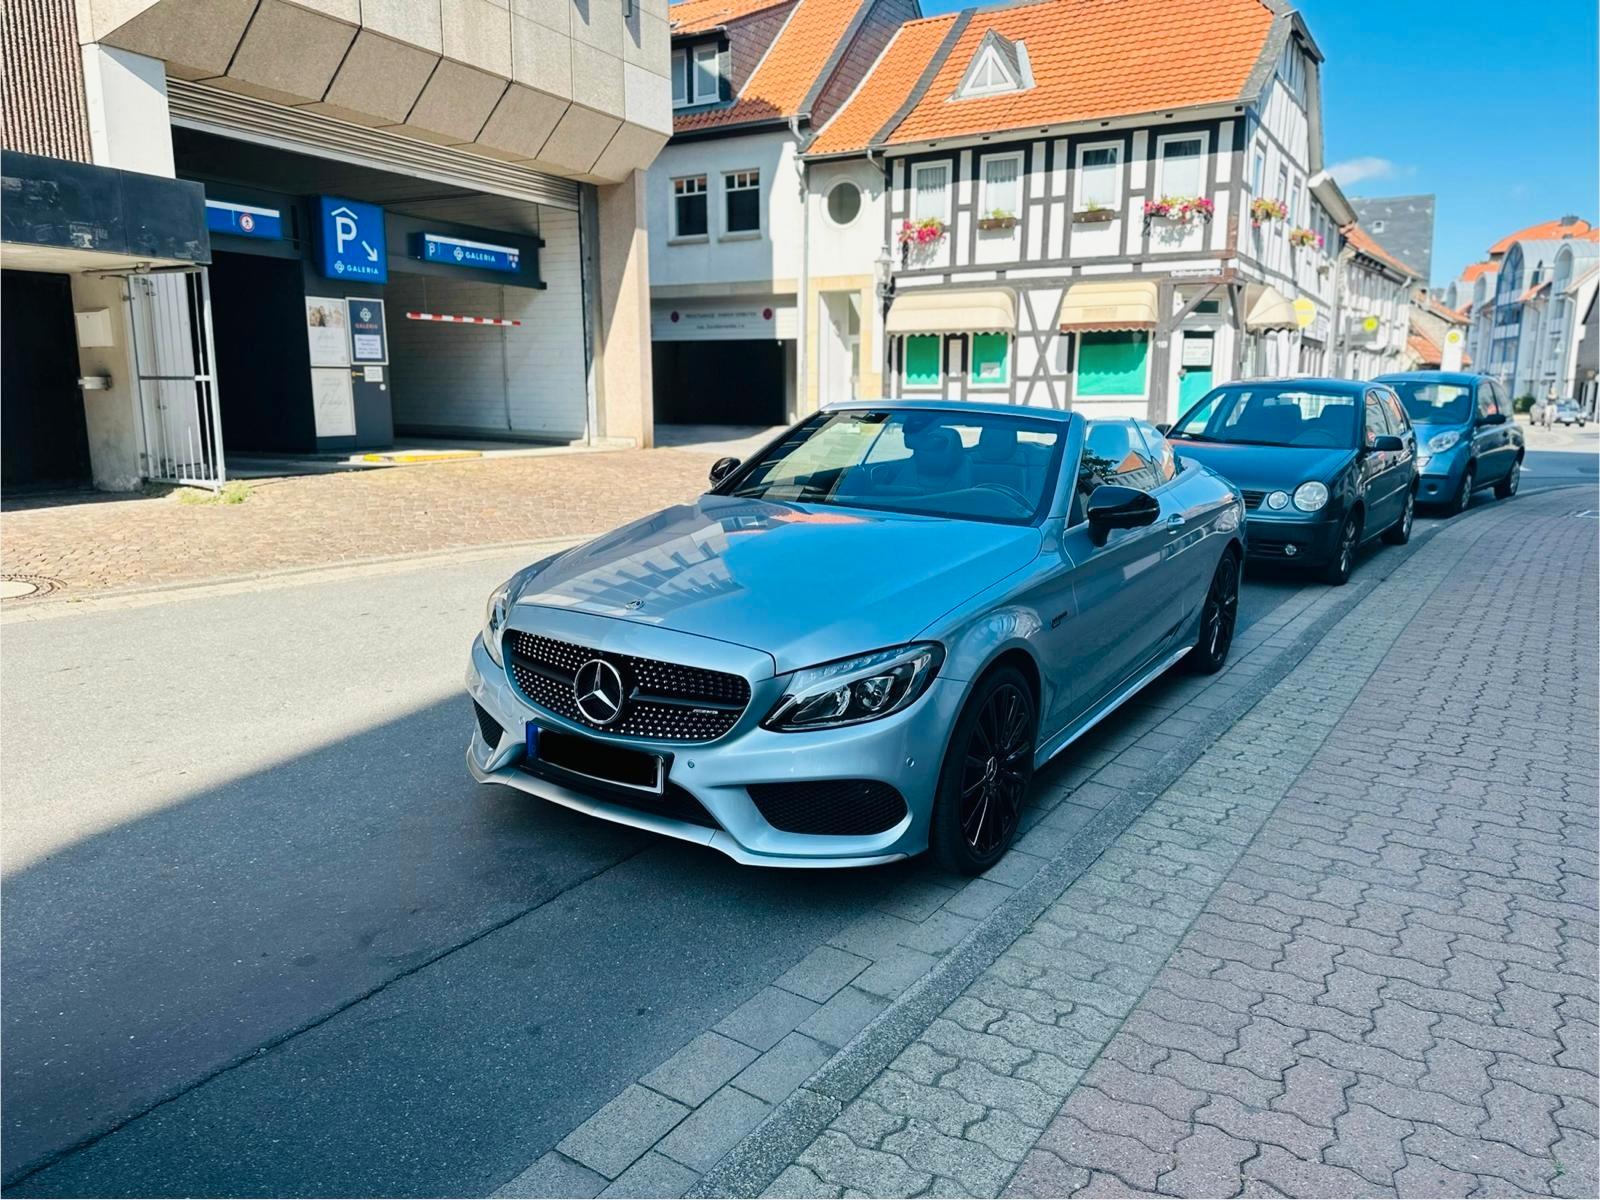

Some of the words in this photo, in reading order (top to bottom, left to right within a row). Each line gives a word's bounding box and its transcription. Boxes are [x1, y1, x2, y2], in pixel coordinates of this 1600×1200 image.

[335, 216, 358, 254] P
[465, 251, 496, 262] GALERIA
[346, 264, 379, 275] GALERIA
